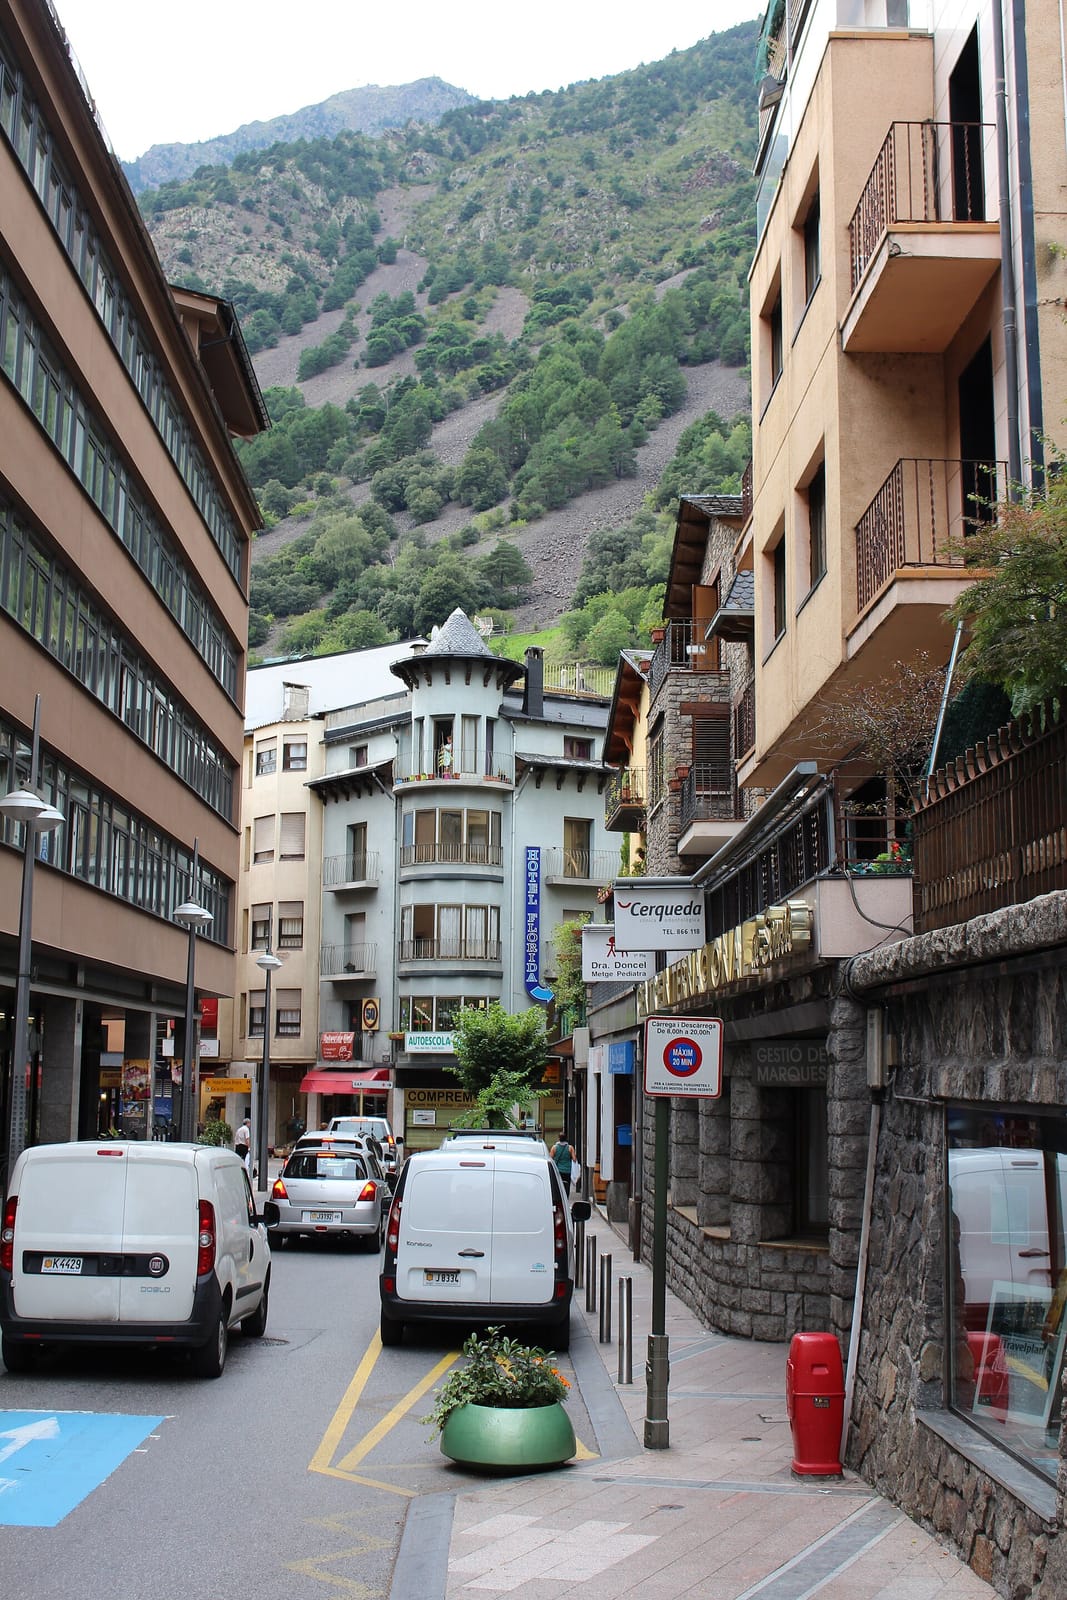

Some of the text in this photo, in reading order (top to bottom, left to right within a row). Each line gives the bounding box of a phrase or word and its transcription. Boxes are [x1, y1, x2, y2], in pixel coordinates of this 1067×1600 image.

[526, 850, 538, 982] HOTEL FLORIDA
[630, 900, 702, 922] Cerqueda
[615, 961, 647, 969] Doncel
[366, 1008, 375, 1021] 50
[409, 1036, 451, 1046] AUTOESCOLA
[757, 1043, 827, 1063] GESTIÓ DE
[672, 1058, 693, 1066] 20 MIN
[757, 1066, 827, 1082] MARQUES
[52, 1258, 81, 1270] K4429
[1003, 1340, 1045, 1355] Travelplan
